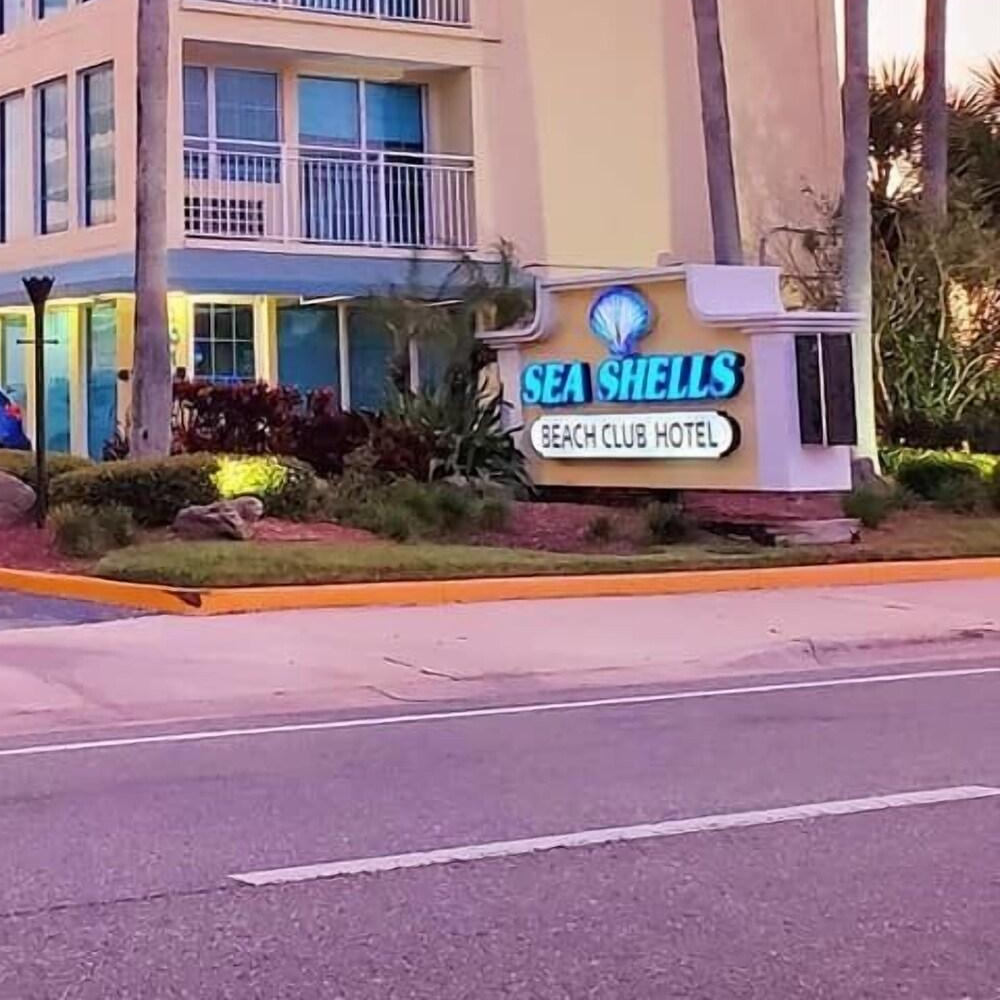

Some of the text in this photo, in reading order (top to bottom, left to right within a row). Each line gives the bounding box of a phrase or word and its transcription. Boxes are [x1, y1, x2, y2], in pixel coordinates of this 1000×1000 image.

[523, 351, 741, 405] SEA SHELLS
[541, 420, 718, 449] BEACH CLUB HOTEL
